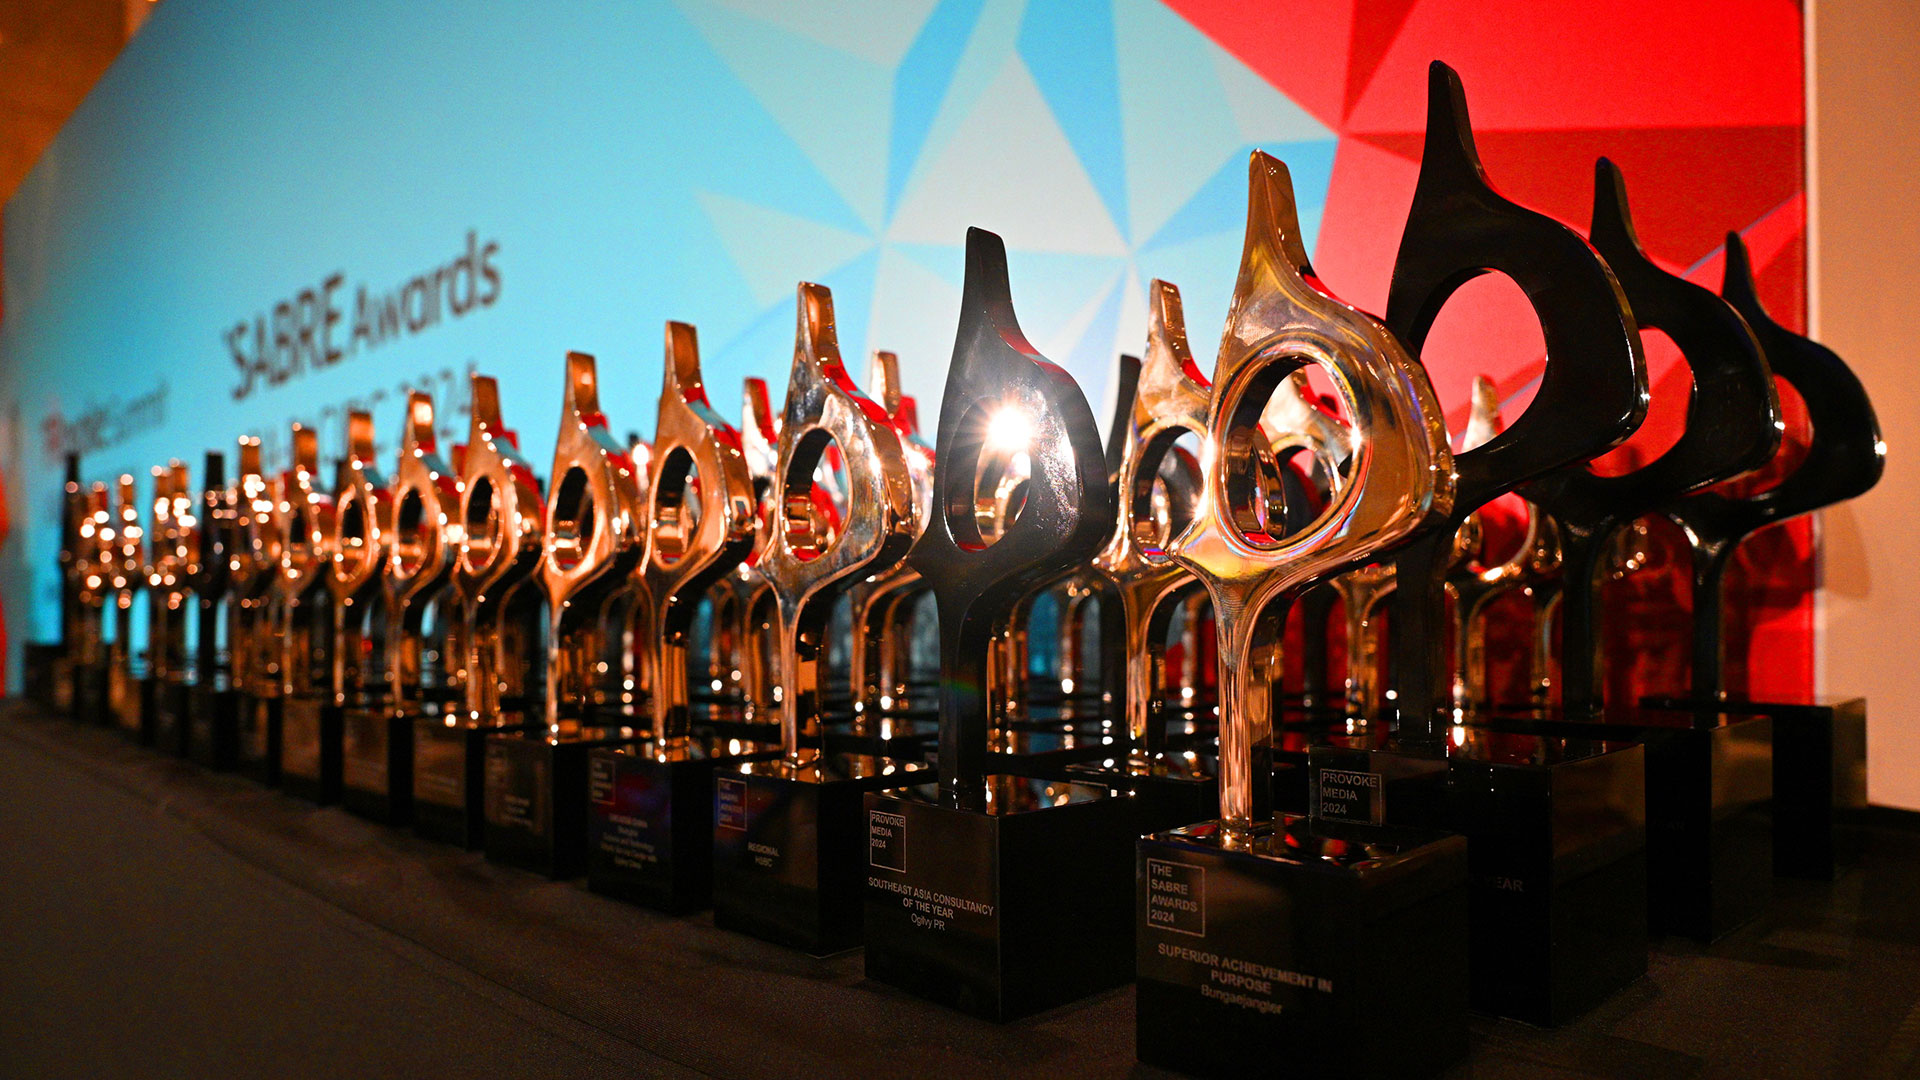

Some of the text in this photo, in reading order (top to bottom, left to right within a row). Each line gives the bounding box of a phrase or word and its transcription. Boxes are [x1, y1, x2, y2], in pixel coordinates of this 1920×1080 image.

[229, 231, 501, 400] SABRE Awards
[1322, 772, 1377, 788] PROVOKE
[1322, 786, 1358, 801] MEDIA
[1322, 802, 1347, 815] 2024
[871, 813, 904, 828] PROVOKE
[871, 825, 893, 838] MEDIA
[748, 841, 780, 857] REGIONAL
[871, 838, 887, 849] 2024
[1151, 863, 1173, 877] THE
[1150, 879, 1188, 895] SABRE
[868, 876, 994, 917] SOUTHEAST ASIA CONSULTANCY
[1150, 895, 1198, 913] AWARDS
[902, 897, 954, 919] OF THE YEAR
[1150, 909, 1175, 923] 2024
[911, 913, 945, 931] Ogilvy PR
[1158, 942, 1332, 993] SUPERIOR ACHIEVEMENT IN
[1211, 969, 1272, 995] PURPOSE
